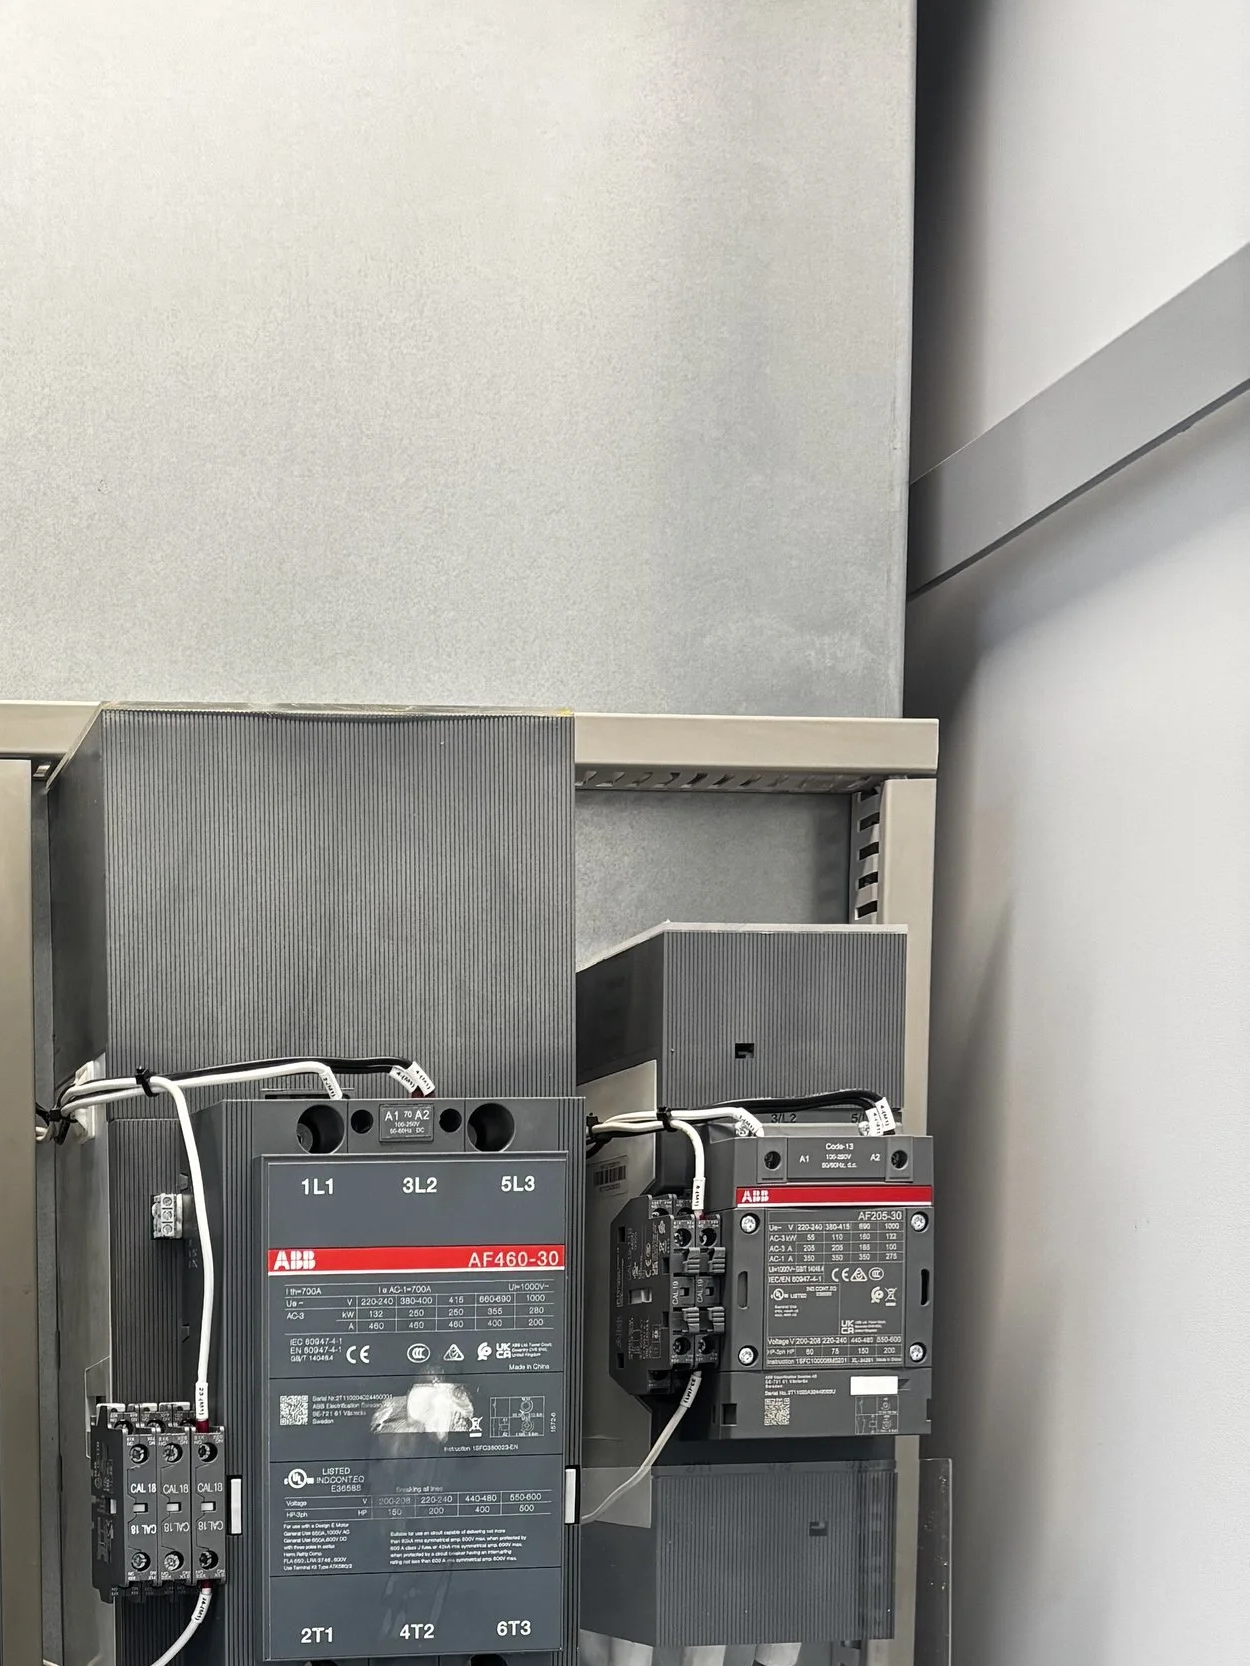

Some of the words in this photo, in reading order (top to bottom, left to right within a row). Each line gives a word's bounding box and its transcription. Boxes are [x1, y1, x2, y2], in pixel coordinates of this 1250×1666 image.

[384, 1111, 399, 1121] A1
[403, 1110, 413, 1118] 70
[414, 1109, 430, 1121] A2
[799, 1154, 810, 1163] A1
[825, 1142, 854, 1151] Code-13
[870, 1153, 881, 1162] A2
[301, 1178, 334, 1195] 1L1
[402, 1177, 438, 1194] 3L2
[500, 1175, 536, 1193] 5L3
[741, 1189, 769, 1203] ABB
[857, 1210, 902, 1221] AF205-30
[797, 1223, 823, 1231] 220-240
[884, 1221, 900, 1229] 1000
[831, 1233, 844, 1241] 110
[273, 1250, 317, 1271] ABB
[467, 1250, 560, 1268] AF460-30
[361, 1297, 394, 1306] 220-240
[400, 1296, 433, 1305] 380-400
[526, 1294, 546, 1302] 1000
[286, 1311, 305, 1320] AC-3
[341, 1310, 355, 1319] kW
[369, 1309, 383, 1318] 132
[408, 1308, 424, 1317] 250
[448, 1308, 464, 1316] 250
[487, 1307, 503, 1315] 355
[528, 1306, 545, 1314] 280
[368, 1321, 385, 1329] 460
[408, 1321, 424, 1329] 460
[448, 1320, 464, 1328] 460
[487, 1319, 503, 1327] 400
[527, 1318, 544, 1326] 200
[289, 1338, 303, 1346] IEC
[305, 1337, 343, 1346] 60947-4-1
[290, 1346, 302, 1354] EN
[305, 1345, 342, 1354] 60947-4-1
[883, 1346, 896, 1354] 200
[508, 1363, 526, 1372] Made
[533, 1361, 550, 1370] China
[322, 1467, 351, 1476] LISTED
[130, 1484, 146, 1493] CAL
[148, 1483, 156, 1493] 18
[163, 1484, 178, 1494] CAL
[180, 1483, 189, 1493] 18
[197, 1482, 212, 1492] CAL
[214, 1482, 223, 1492] 18
[286, 1500, 307, 1508] Voltage
[420, 1495, 453, 1504] 220-240
[465, 1494, 497, 1503] 440-480
[510, 1493, 542, 1502] 550-600
[286, 1511, 308, 1519] HP-3ph
[358, 1509, 368, 1517] HP
[429, 1506, 445, 1515] 200
[475, 1505, 491, 1514] 400
[519, 1504, 535, 1513] 500
[130, 1524, 140, 1535] 18
[143, 1524, 157, 1535] CAL
[163, 1522, 173, 1533] 18
[174, 1522, 190, 1532] CAL
[198, 1521, 207, 1531] 18
[207, 1520, 224, 1531] CAL
[399, 1623, 435, 1640] 4T2
[497, 1619, 532, 1637] 6T3
[300, 1627, 334, 1643] 2T1
